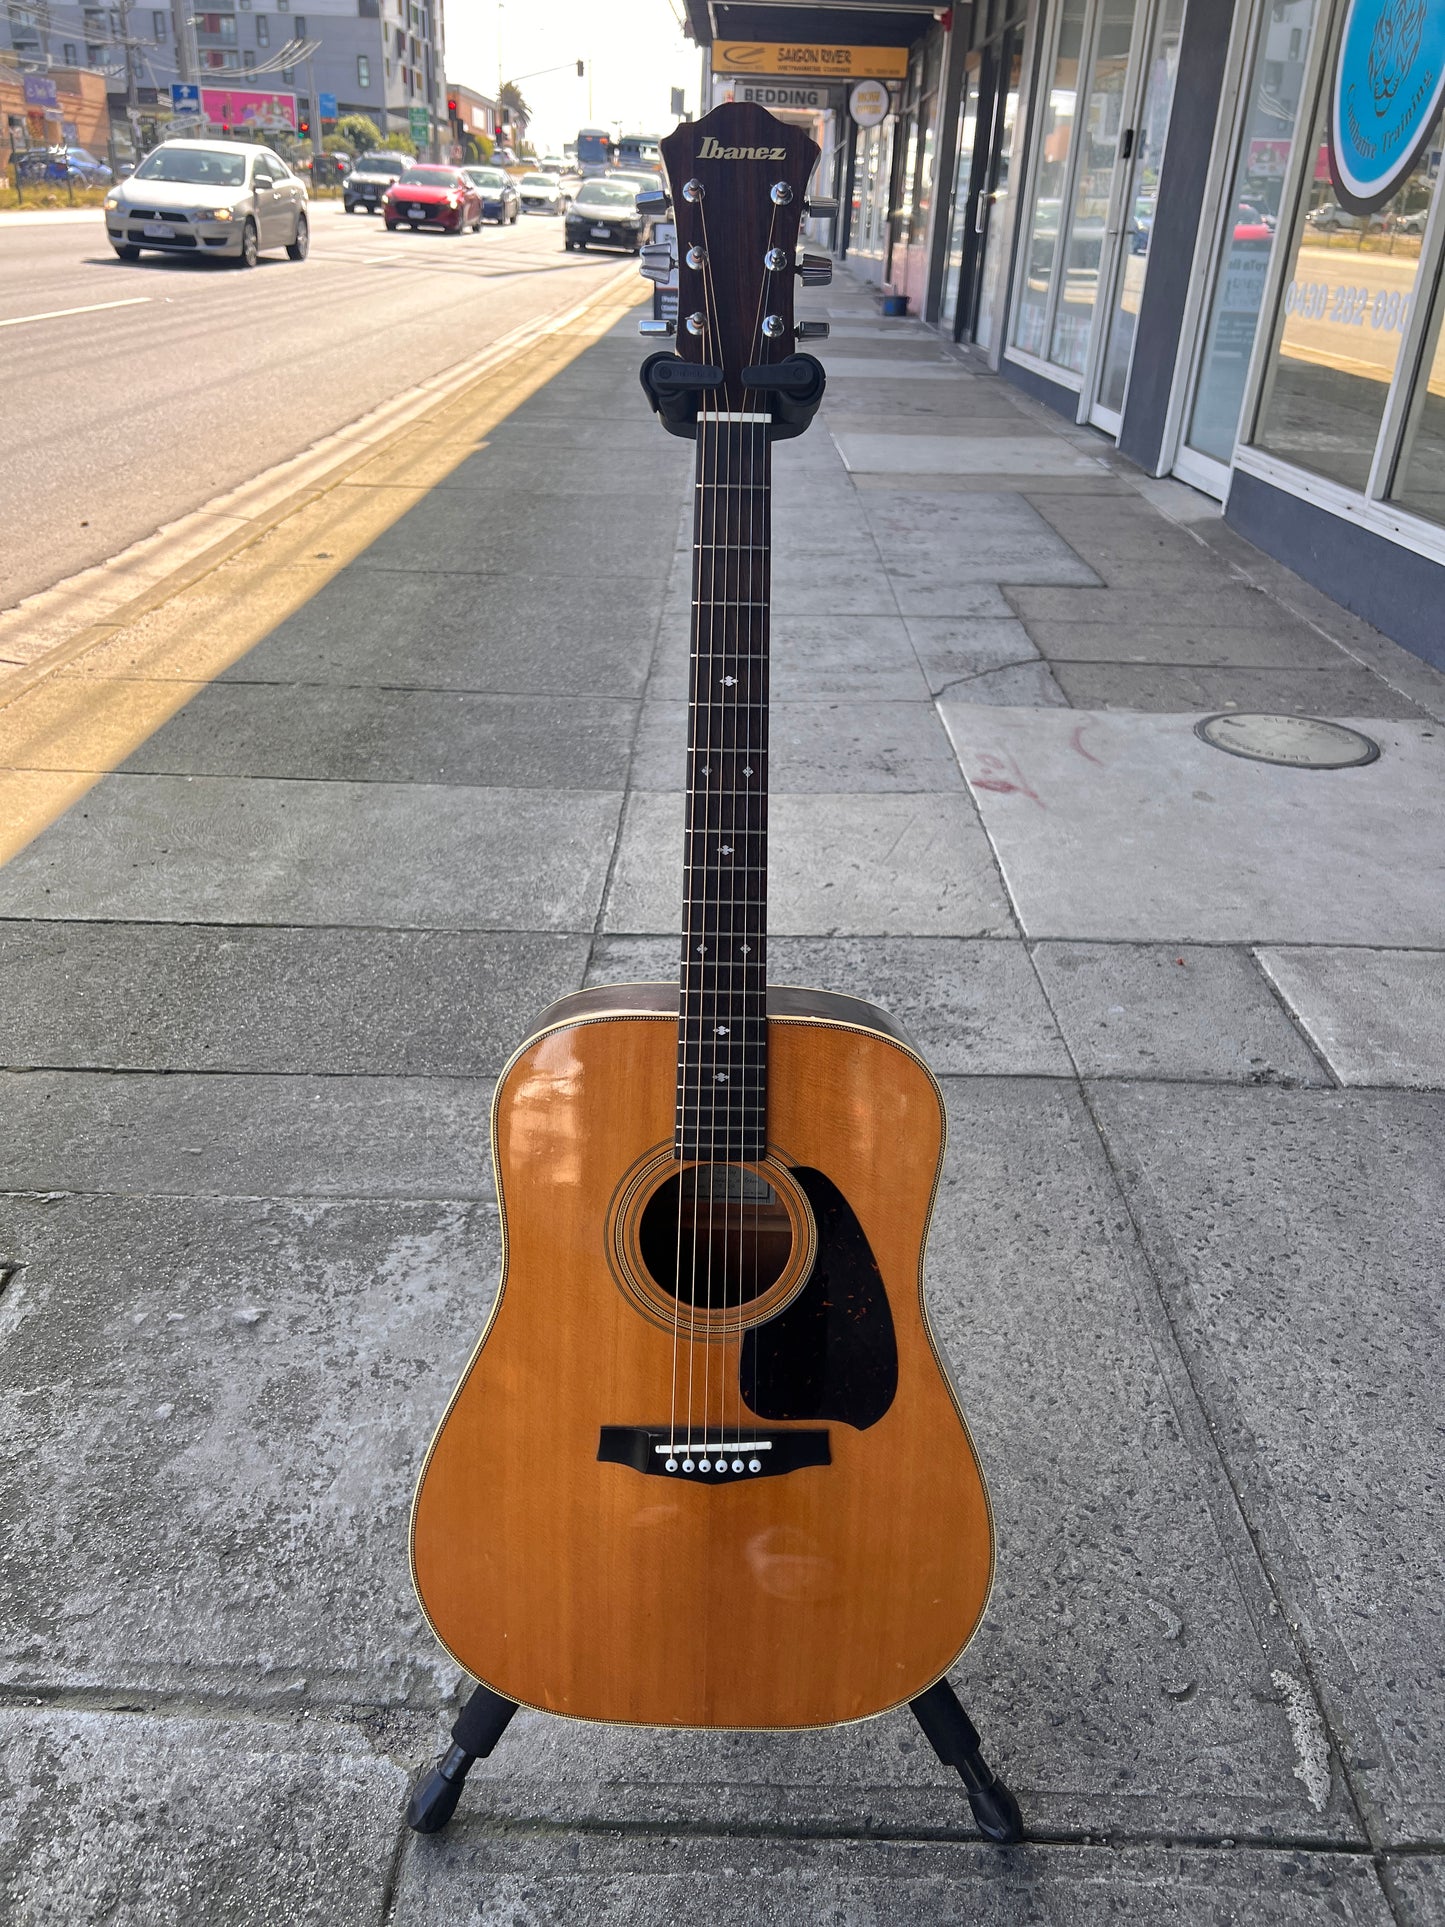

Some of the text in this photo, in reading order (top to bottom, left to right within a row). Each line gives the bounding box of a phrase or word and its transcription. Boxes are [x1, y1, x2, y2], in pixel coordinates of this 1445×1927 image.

[777, 47, 852, 64] SAIGON RIVER
[744, 88, 819, 105] BEDDING
[857, 91, 880, 102] NOW
[1381, 69, 1433, 154] Training
[695, 136, 787, 160] Ibanez
[1284, 280, 1328, 320] 0430
[1330, 285, 1369, 326] 282
